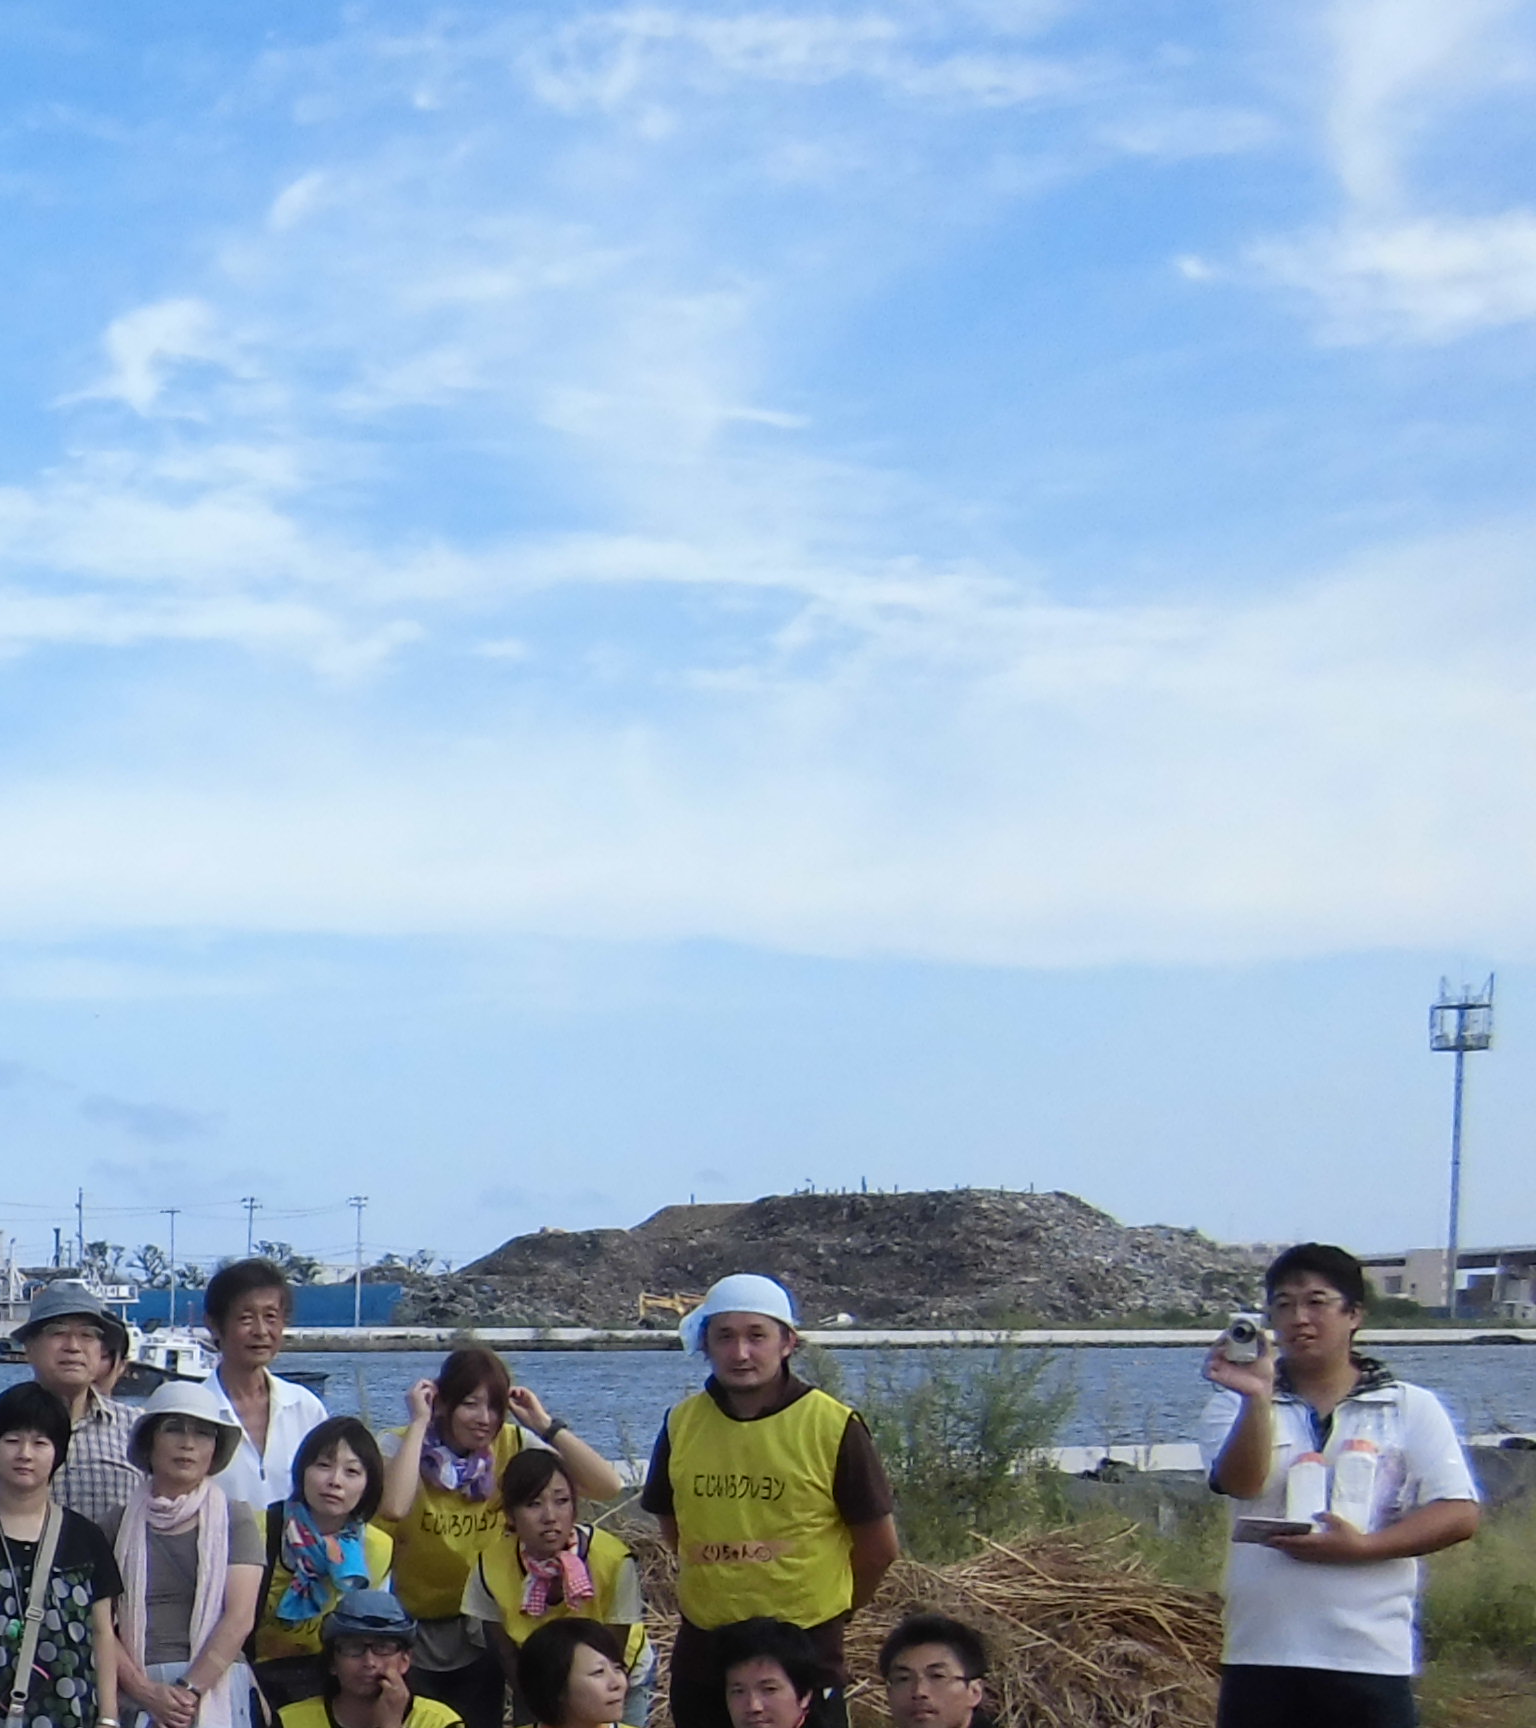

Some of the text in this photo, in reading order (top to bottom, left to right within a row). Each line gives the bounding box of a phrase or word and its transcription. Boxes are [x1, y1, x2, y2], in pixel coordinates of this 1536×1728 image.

[693, 1474, 786, 1501] にじいろクレヨン
